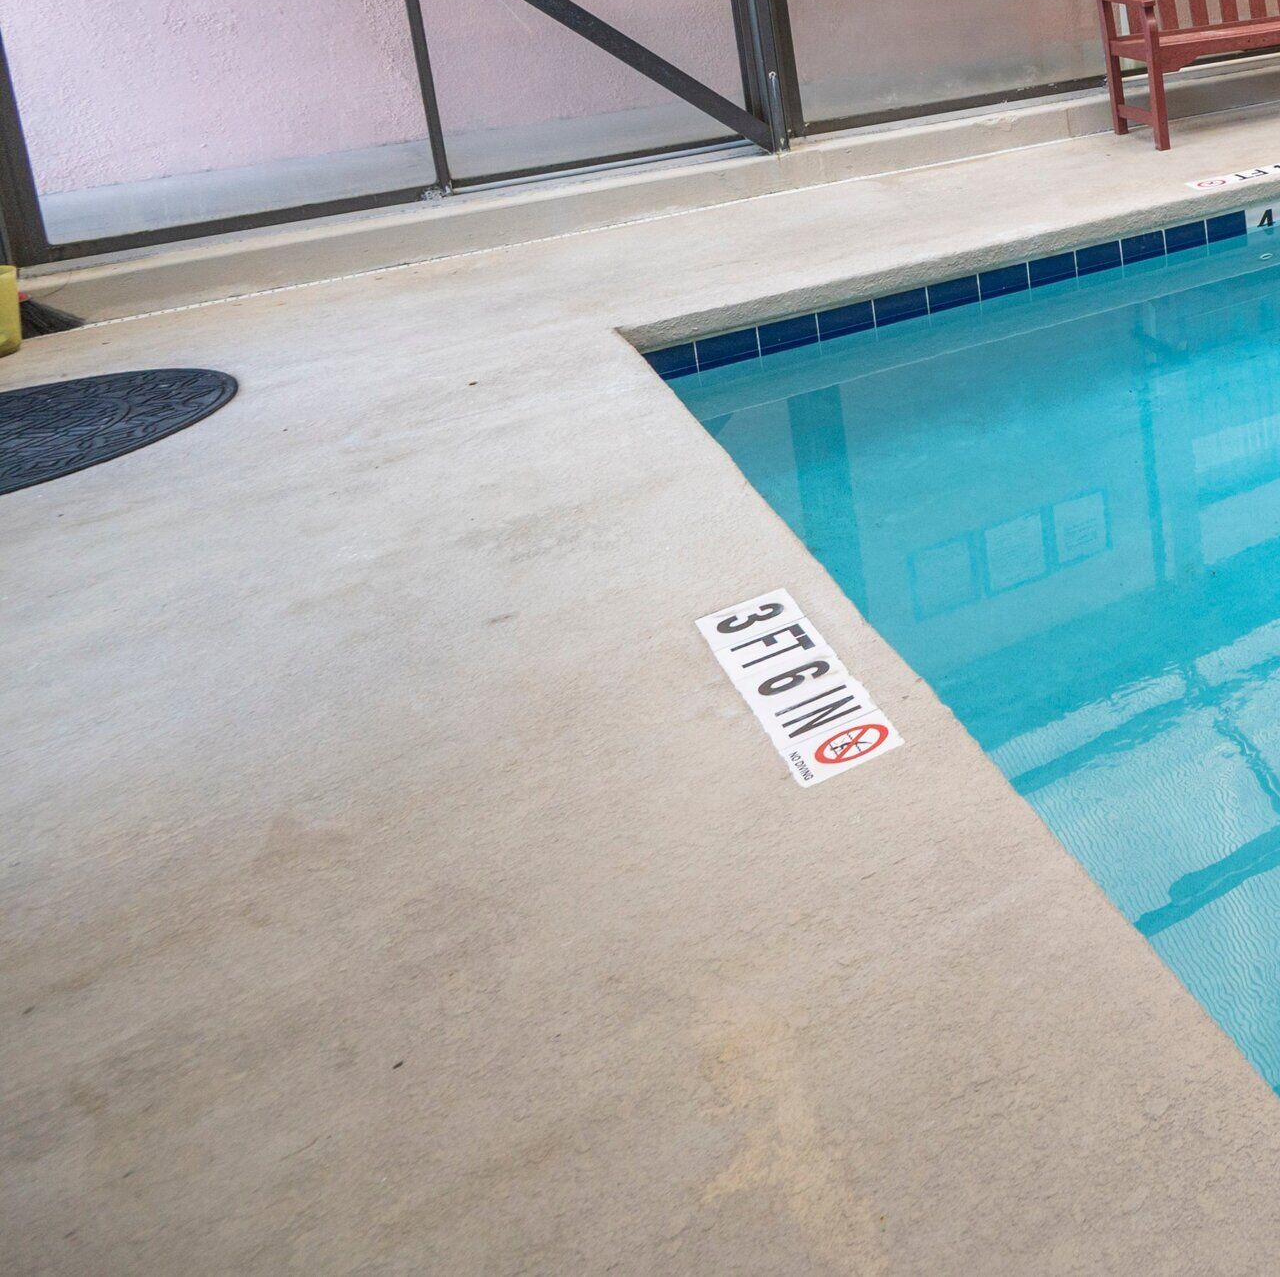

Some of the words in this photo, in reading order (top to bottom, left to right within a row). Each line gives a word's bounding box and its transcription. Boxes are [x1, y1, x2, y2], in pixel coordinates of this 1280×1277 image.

[1257, 208, 1276, 227] 4
[716, 602, 785, 634] 3
[730, 623, 816, 669] FT
[789, 750, 801, 762] NO
[794, 760, 814, 781] DIVING
